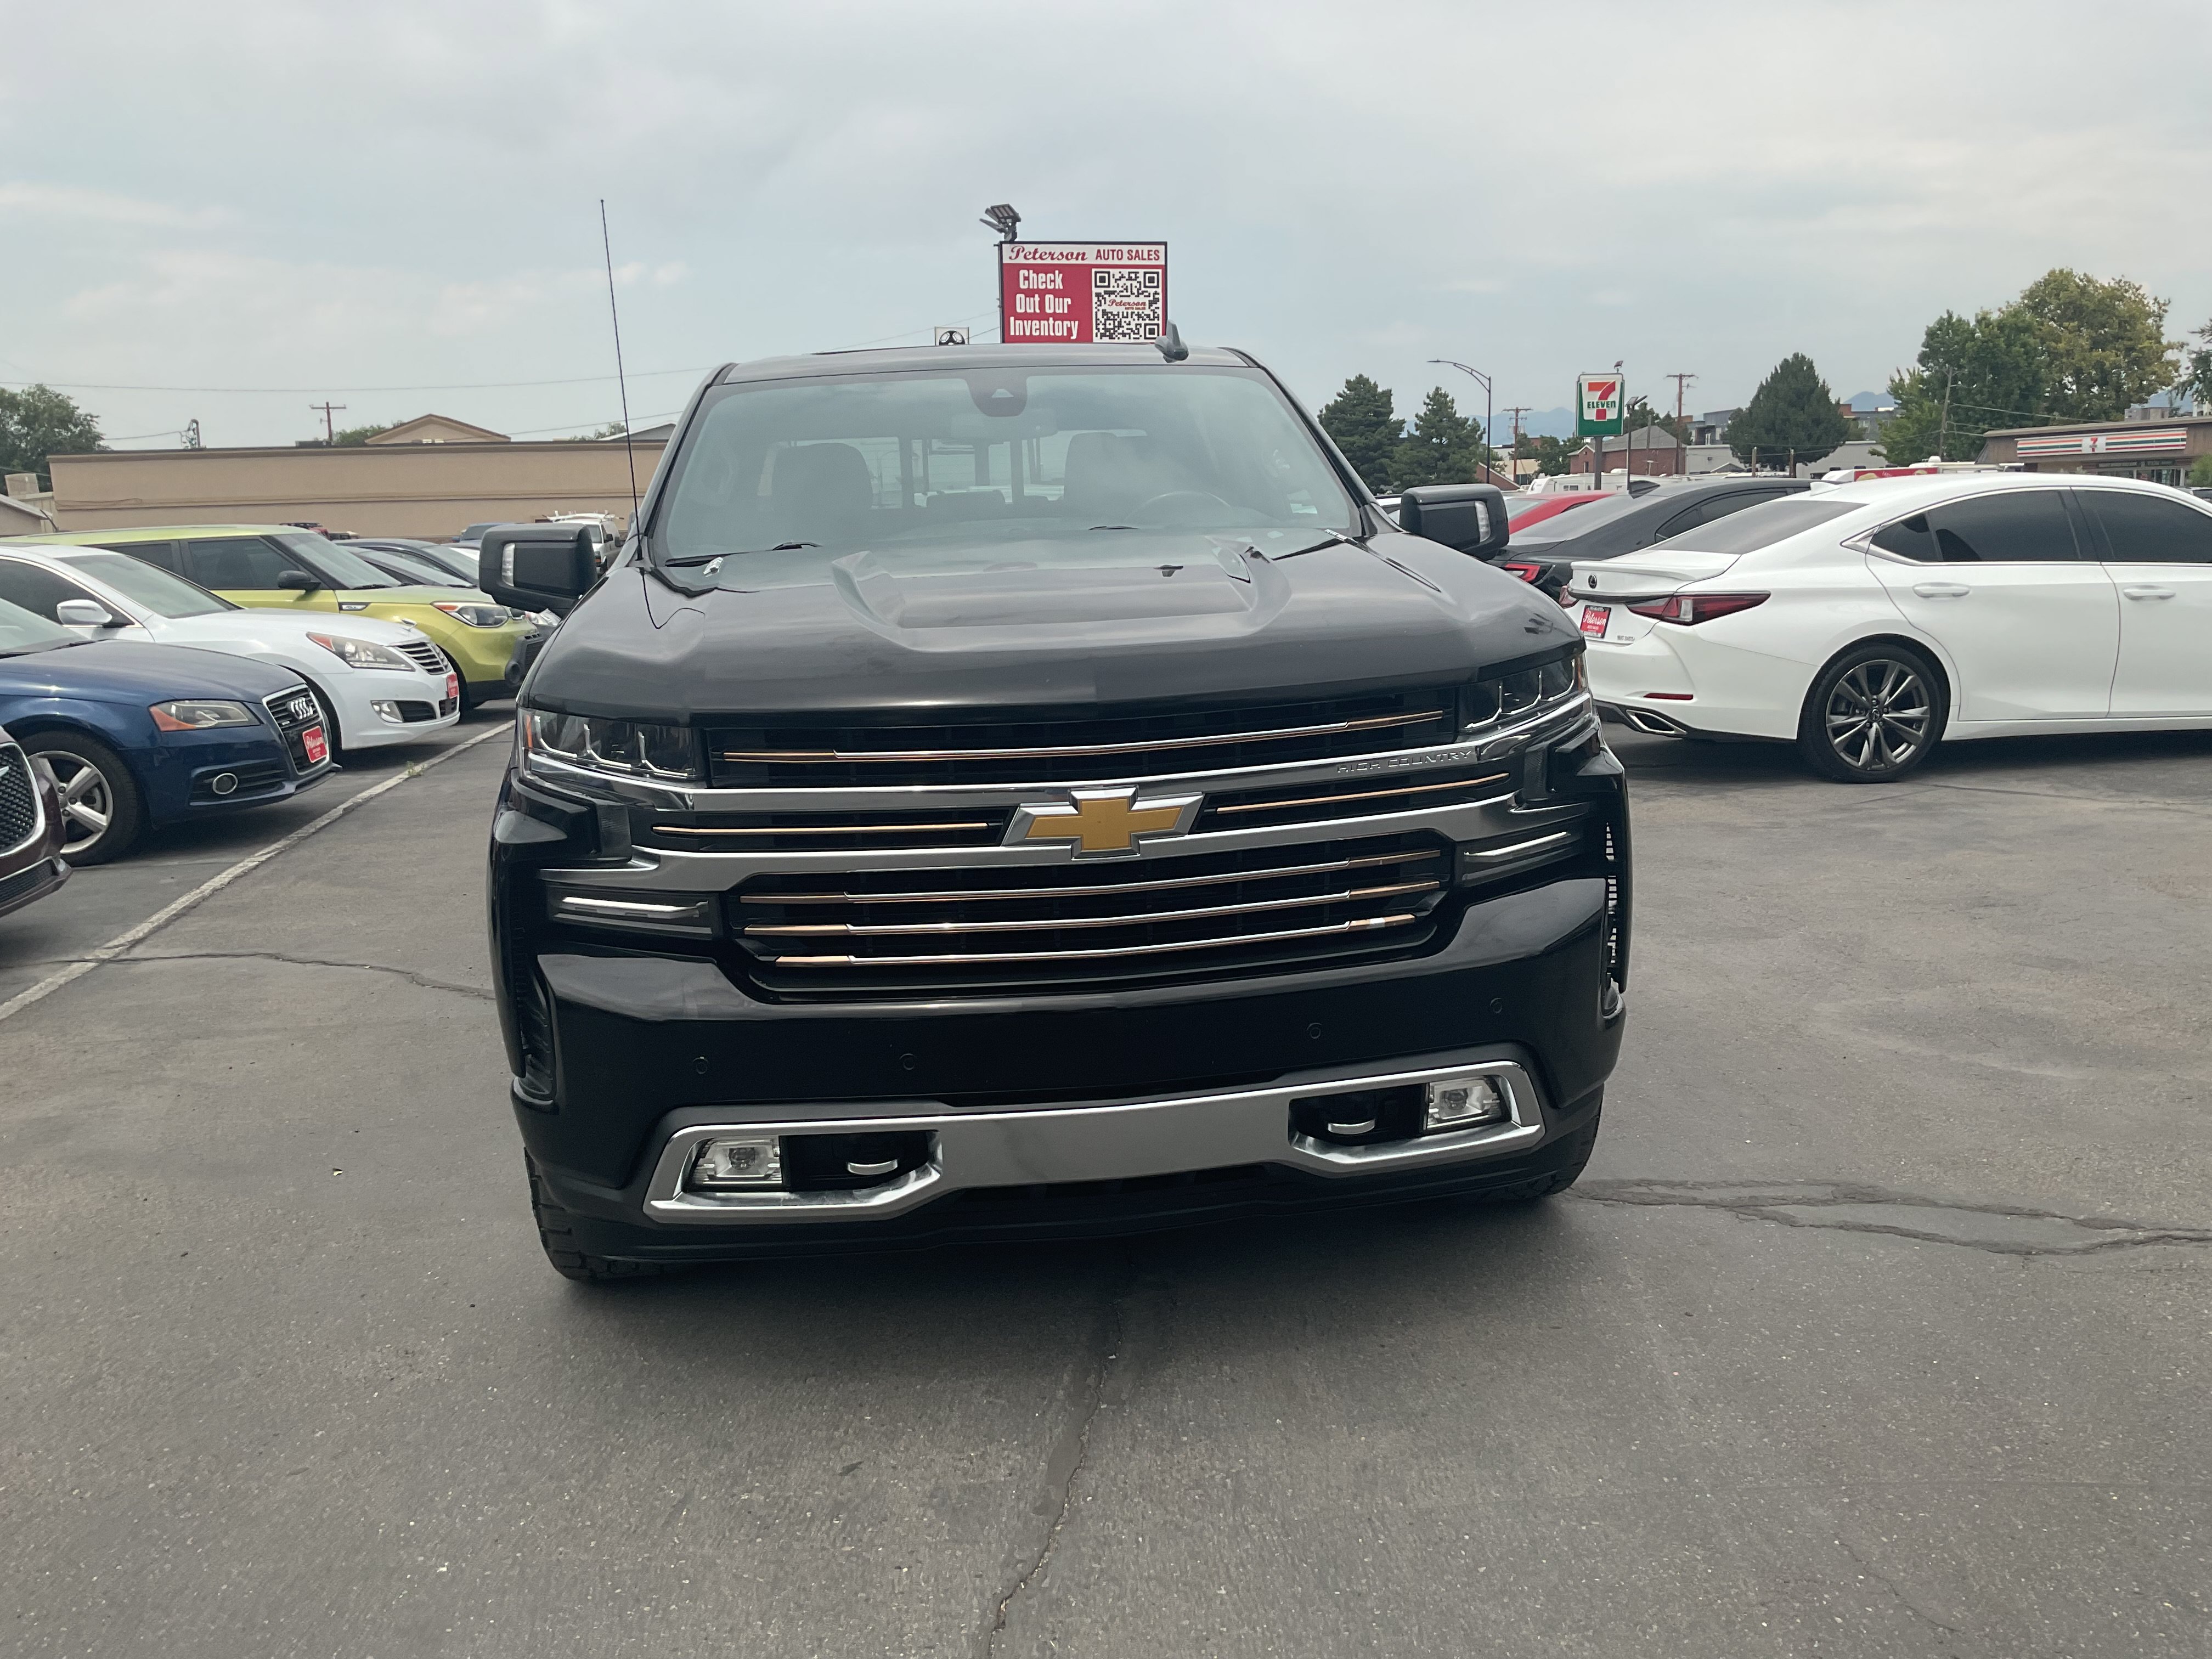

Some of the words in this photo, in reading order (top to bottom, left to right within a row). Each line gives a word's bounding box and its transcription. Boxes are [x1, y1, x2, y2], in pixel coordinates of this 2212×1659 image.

[1009, 245, 1088, 261] Peterson
[1096, 249, 1124, 261] AUTO
[1127, 250, 1160, 261] SALES
[1019, 269, 1063, 289] Check
[1016, 294, 1040, 313] Out
[1045, 294, 1071, 313] Our
[1108, 298, 1146, 307] Peterson
[1010, 317, 1079, 340] Inventory
[1588, 380, 1616, 420] 7
[1582, 610, 1607, 626] Peterson
[1338, 761, 1381, 773] HIGH
[1388, 751, 1472, 768] COUNTRY
